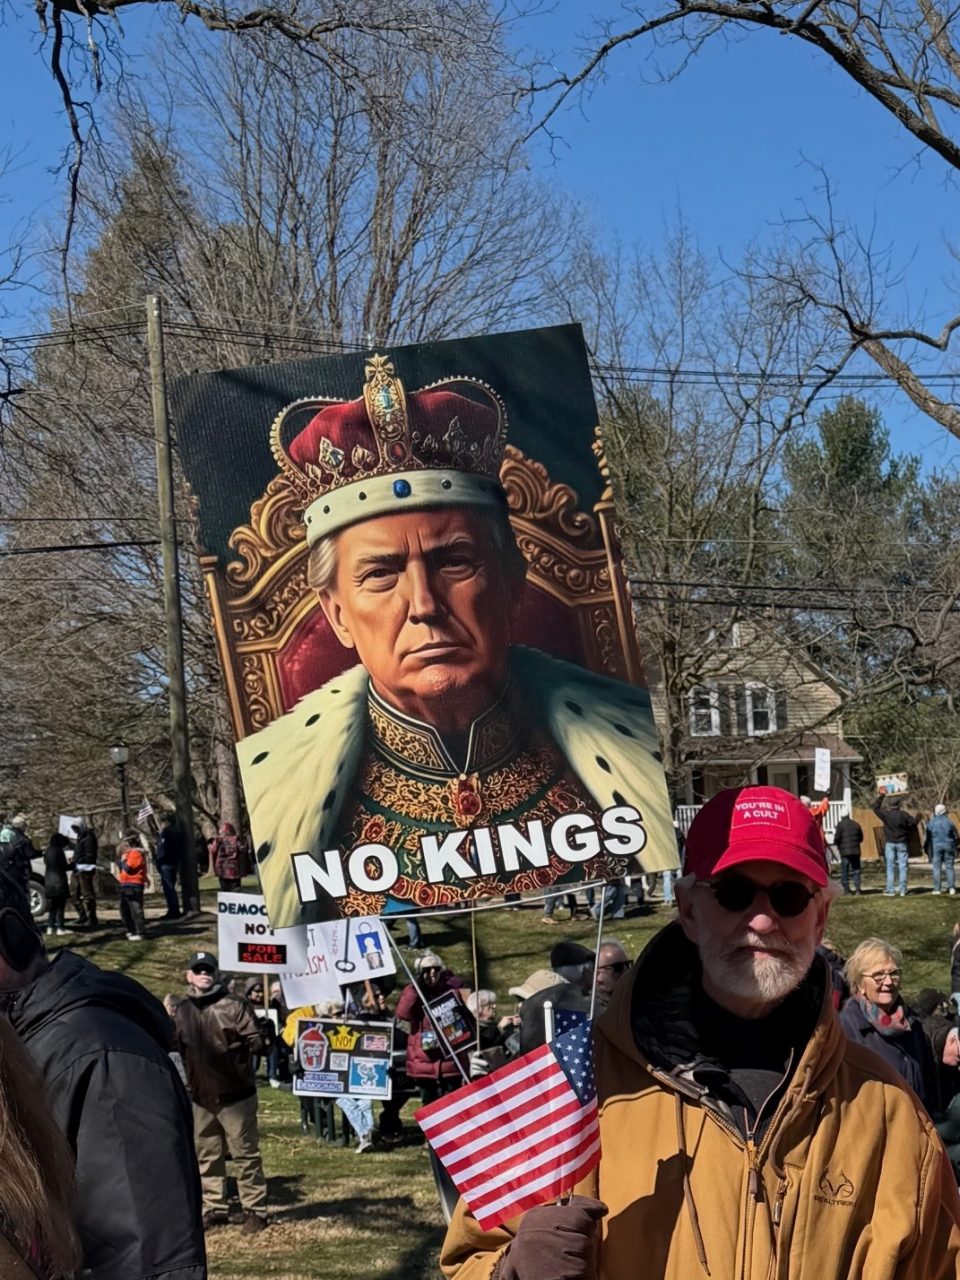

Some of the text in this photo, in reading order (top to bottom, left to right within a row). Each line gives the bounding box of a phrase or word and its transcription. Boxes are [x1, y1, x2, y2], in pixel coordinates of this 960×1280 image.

[735, 801, 785, 813] YOU'RE IN
[743, 810, 779, 820] A CULT
[291, 805, 648, 903] NO KINGS
[247, 943, 277, 954] FOR
[242, 952, 283, 964] SALE
